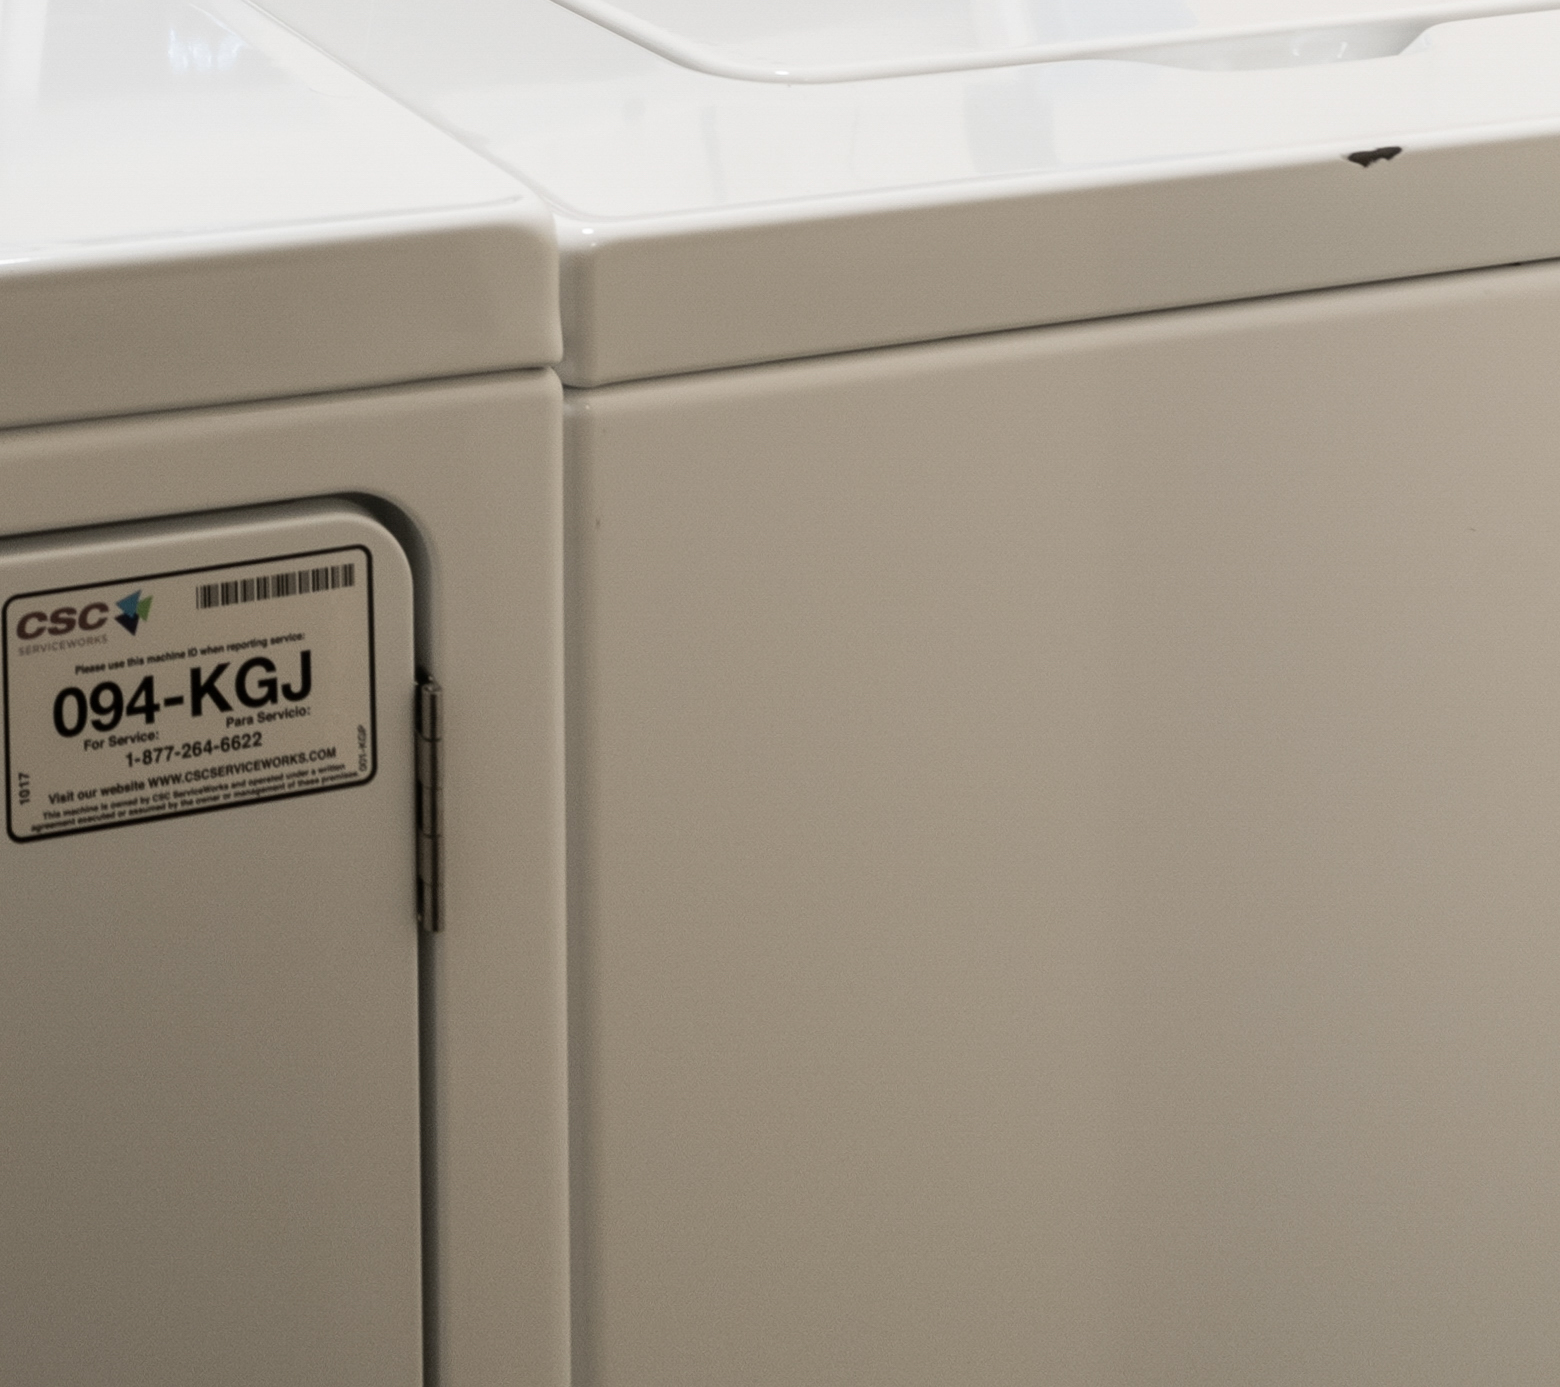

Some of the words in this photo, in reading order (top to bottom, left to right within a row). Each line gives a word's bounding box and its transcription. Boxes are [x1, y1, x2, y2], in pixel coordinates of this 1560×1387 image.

[16, 601, 110, 641] CSC
[52, 649, 312, 739] 094-KGJ
[83, 738, 106, 752] For
[107, 731, 159, 748] Service:
[125, 730, 263, 768] 1-877-264-6622
